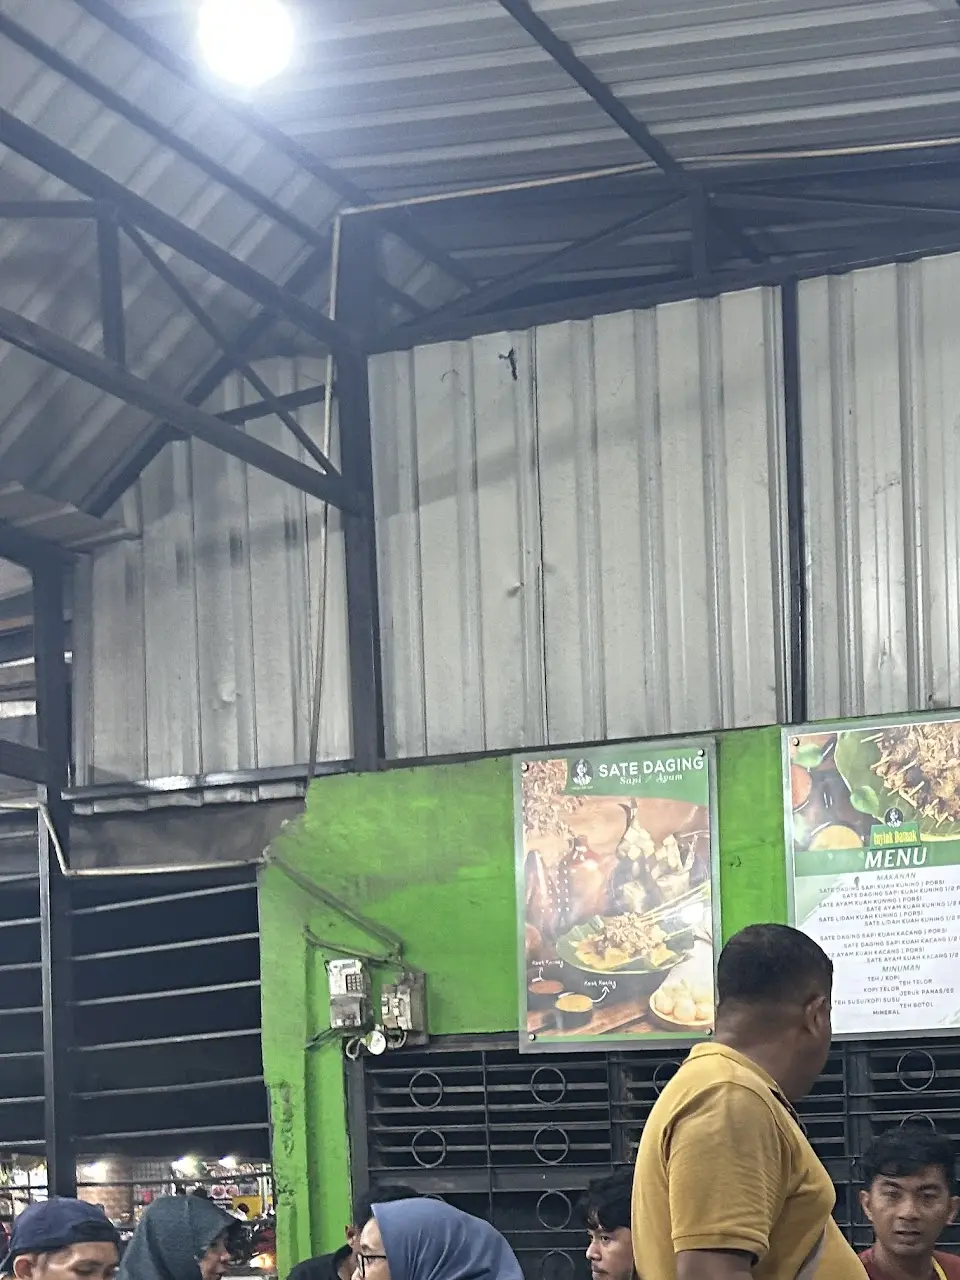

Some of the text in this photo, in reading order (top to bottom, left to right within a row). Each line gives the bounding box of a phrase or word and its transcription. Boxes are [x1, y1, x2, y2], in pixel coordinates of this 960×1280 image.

[598, 756, 704, 778] SATE DAGING
[619, 776, 642, 785] Sapi
[864, 847, 927, 869] MENU
[876, 872, 916, 881] MAKANAN
[882, 964, 921, 972] MINUMAN
